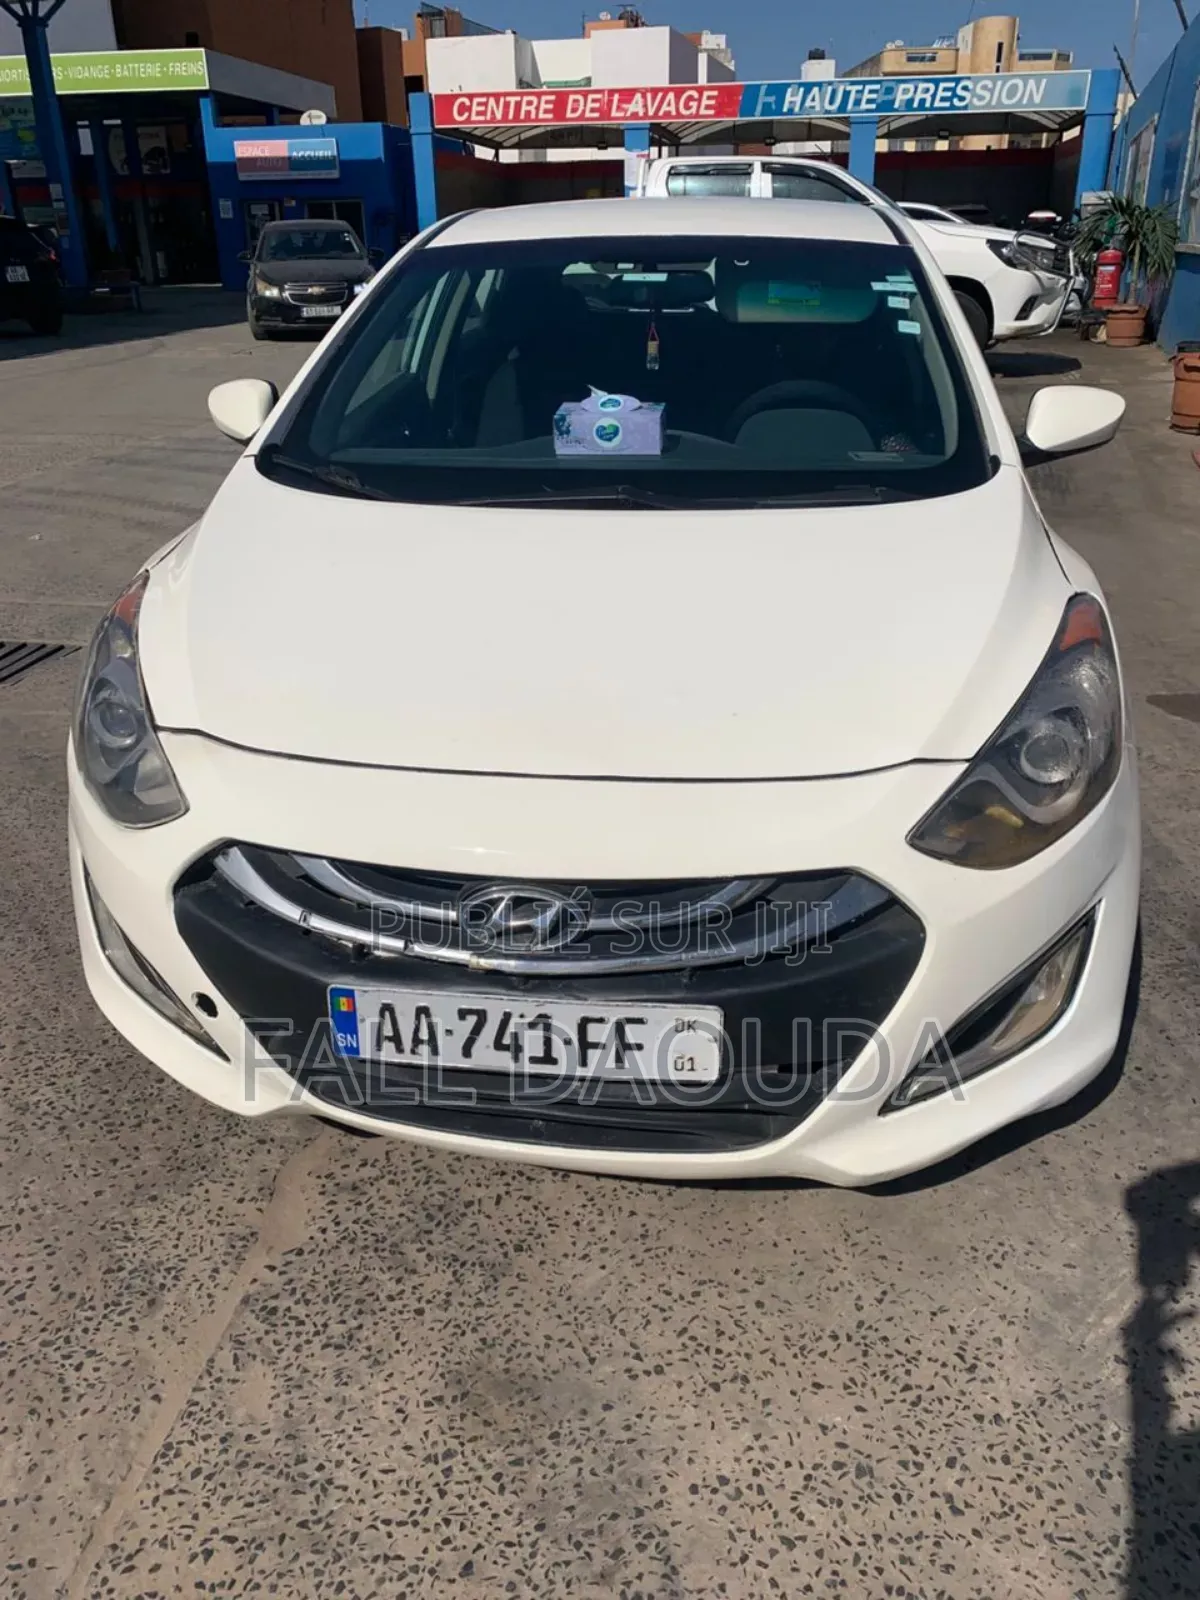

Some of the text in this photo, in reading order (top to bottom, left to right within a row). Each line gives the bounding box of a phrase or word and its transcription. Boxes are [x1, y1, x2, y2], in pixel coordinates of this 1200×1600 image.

[68, 65, 110, 79] VIDANGE
[116, 63, 161, 78] BATTERIE
[169, 61, 204, 76] FREINS
[782, 83, 880, 114] HAUTE
[893, 78, 1047, 110] PRESSION
[452, 90, 719, 122] CENTRE DE LAVAGE
[292, 149, 333, 161] ACCUEIL
[674, 1017, 697, 1034] DK
[336, 1031, 358, 1049] SN
[376, 1002, 648, 1070] AA-741-FF
